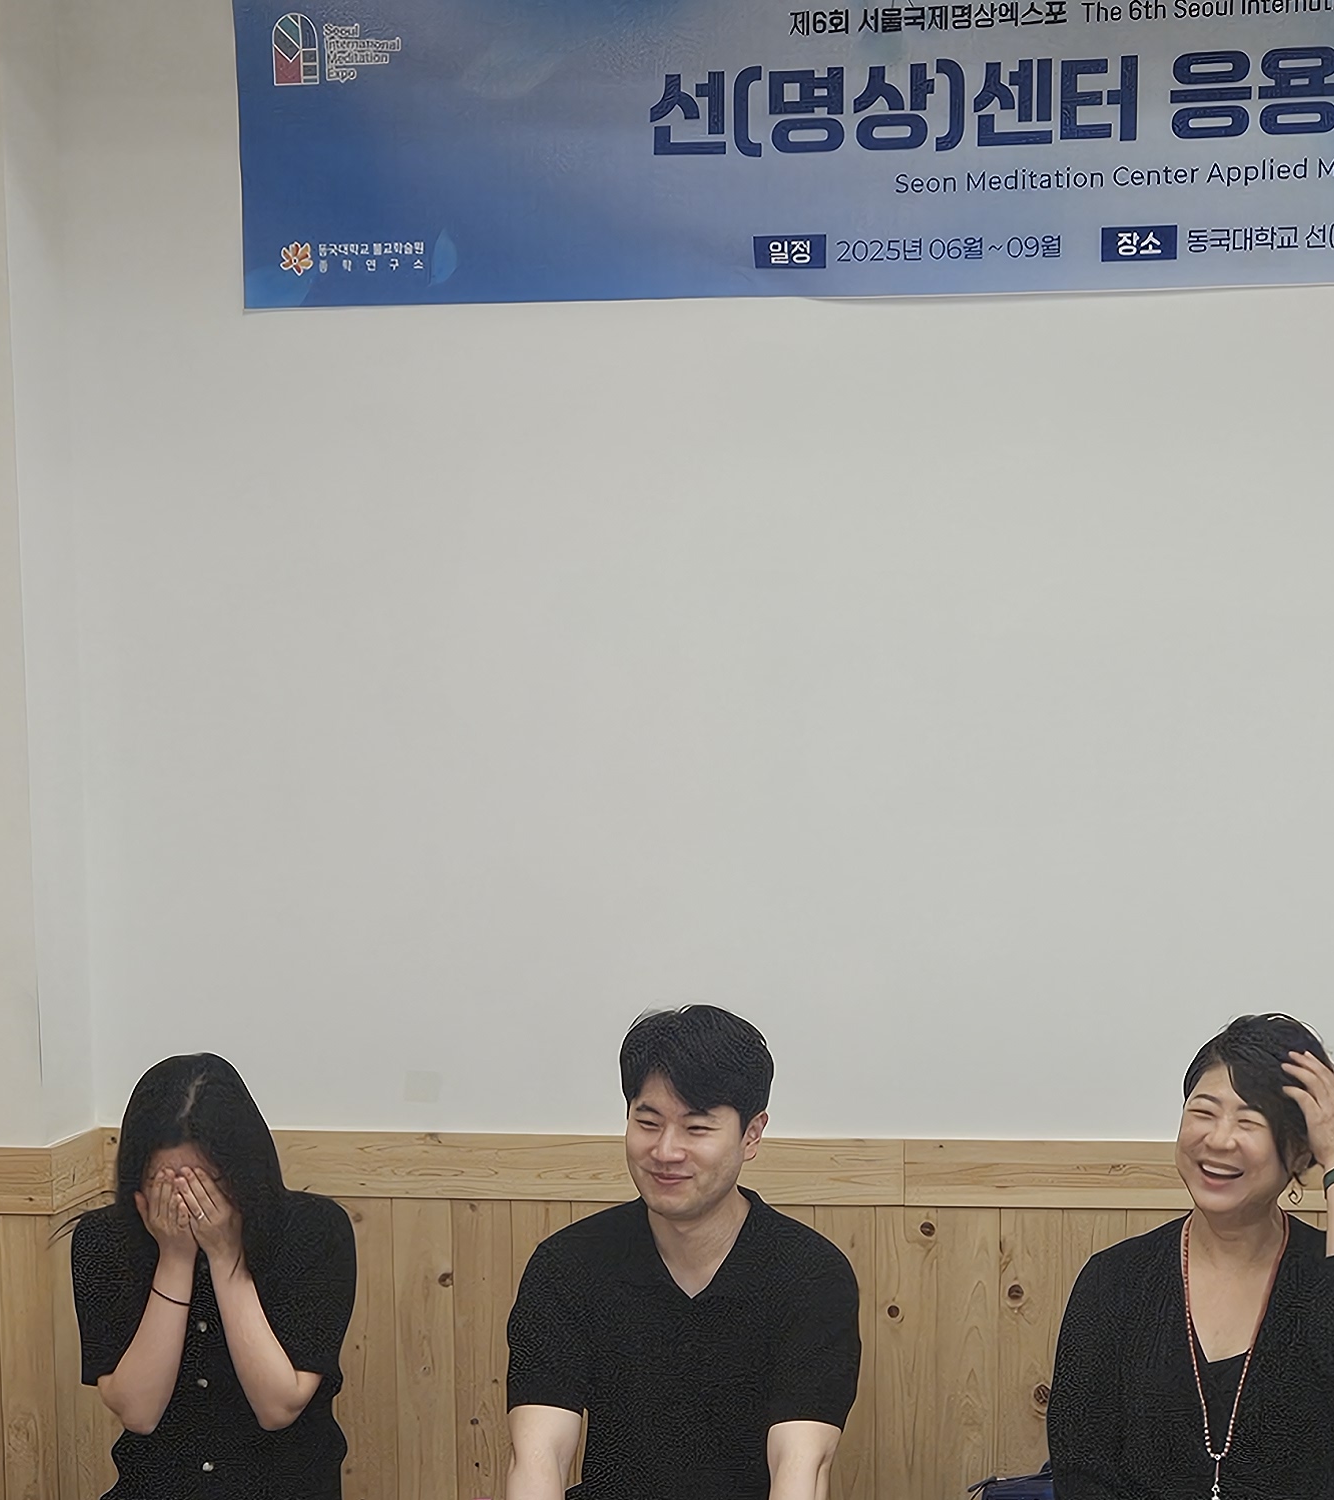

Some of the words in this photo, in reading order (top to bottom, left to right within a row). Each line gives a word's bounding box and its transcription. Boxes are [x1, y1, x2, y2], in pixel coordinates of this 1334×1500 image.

[789, 8, 849, 36] 제6회
[1082, 2, 1121, 23] The
[1129, 0, 1167, 21] 6th
[1174, 0, 1234, 19] Seoul
[649, 55, 1139, 158] 선(명상)센터
[895, 173, 957, 194] Seon
[966, 166, 1104, 192] Meditation
[1112, 165, 1199, 188] Center
[1206, 158, 1310, 188] Applied
[767, 239, 812, 265] 일정
[835, 236, 923, 262] 2025년
[1115, 231, 1164, 257] 장소
[1187, 225, 1299, 253] 동국대학교
